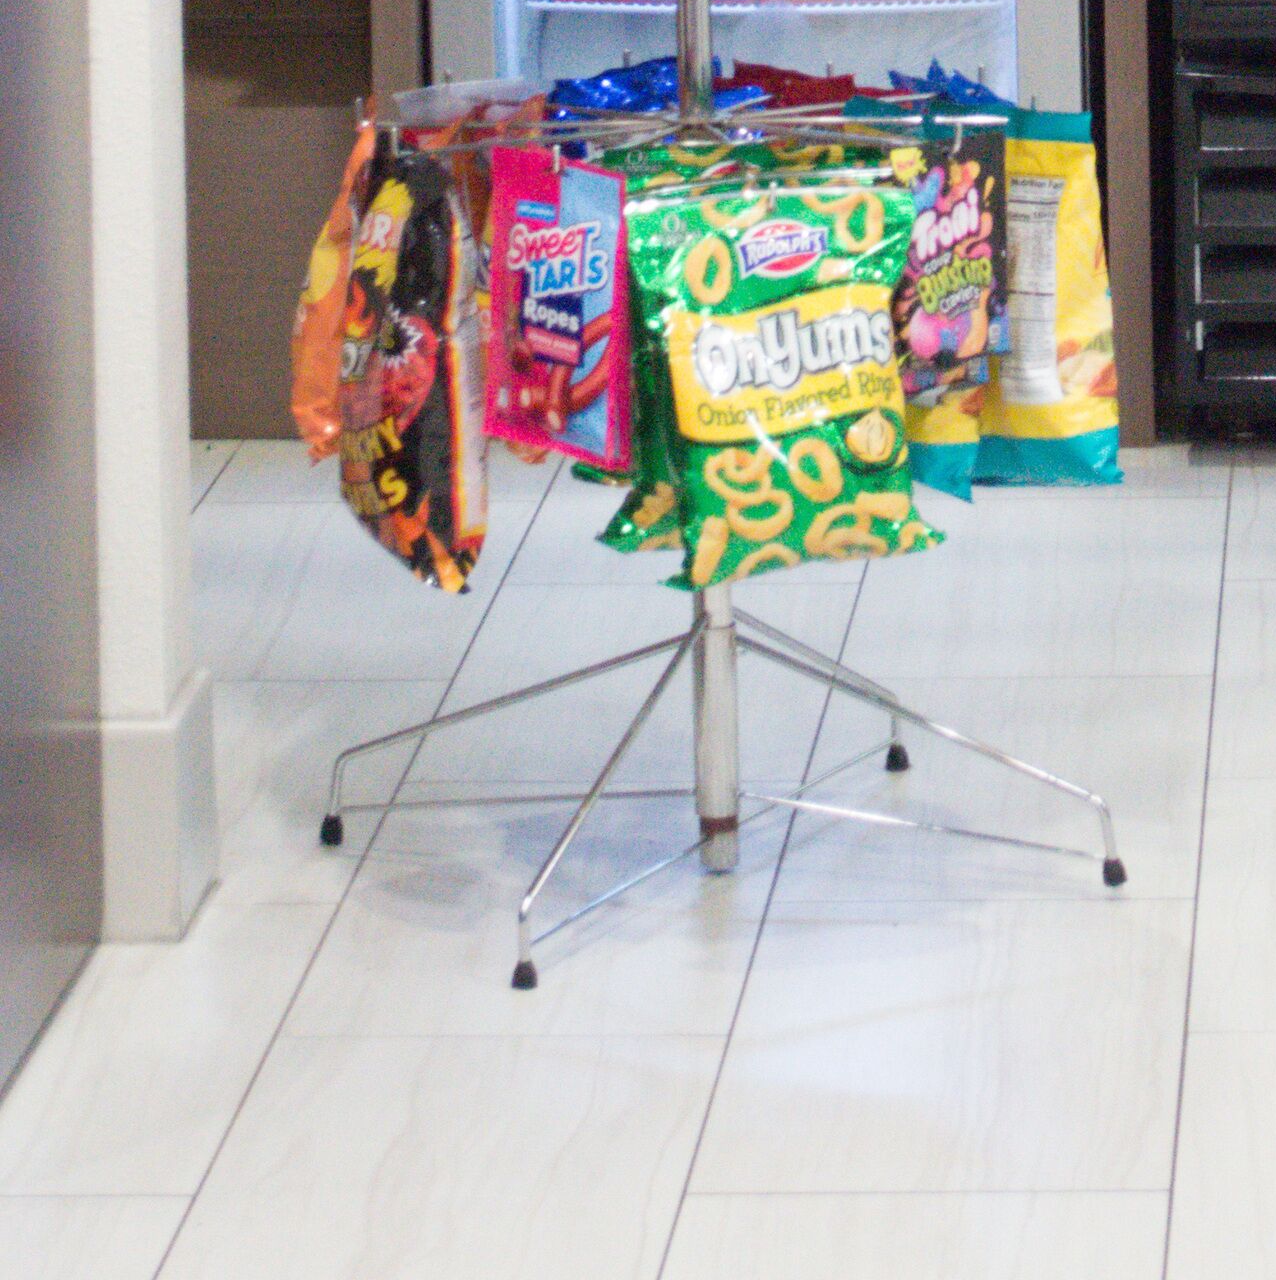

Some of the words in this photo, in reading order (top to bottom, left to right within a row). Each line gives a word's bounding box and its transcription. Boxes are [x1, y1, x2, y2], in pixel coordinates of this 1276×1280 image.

[910, 186, 980, 262] Trolli
[523, 297, 581, 335] Ropes
[764, 379, 851, 421] Flavored
